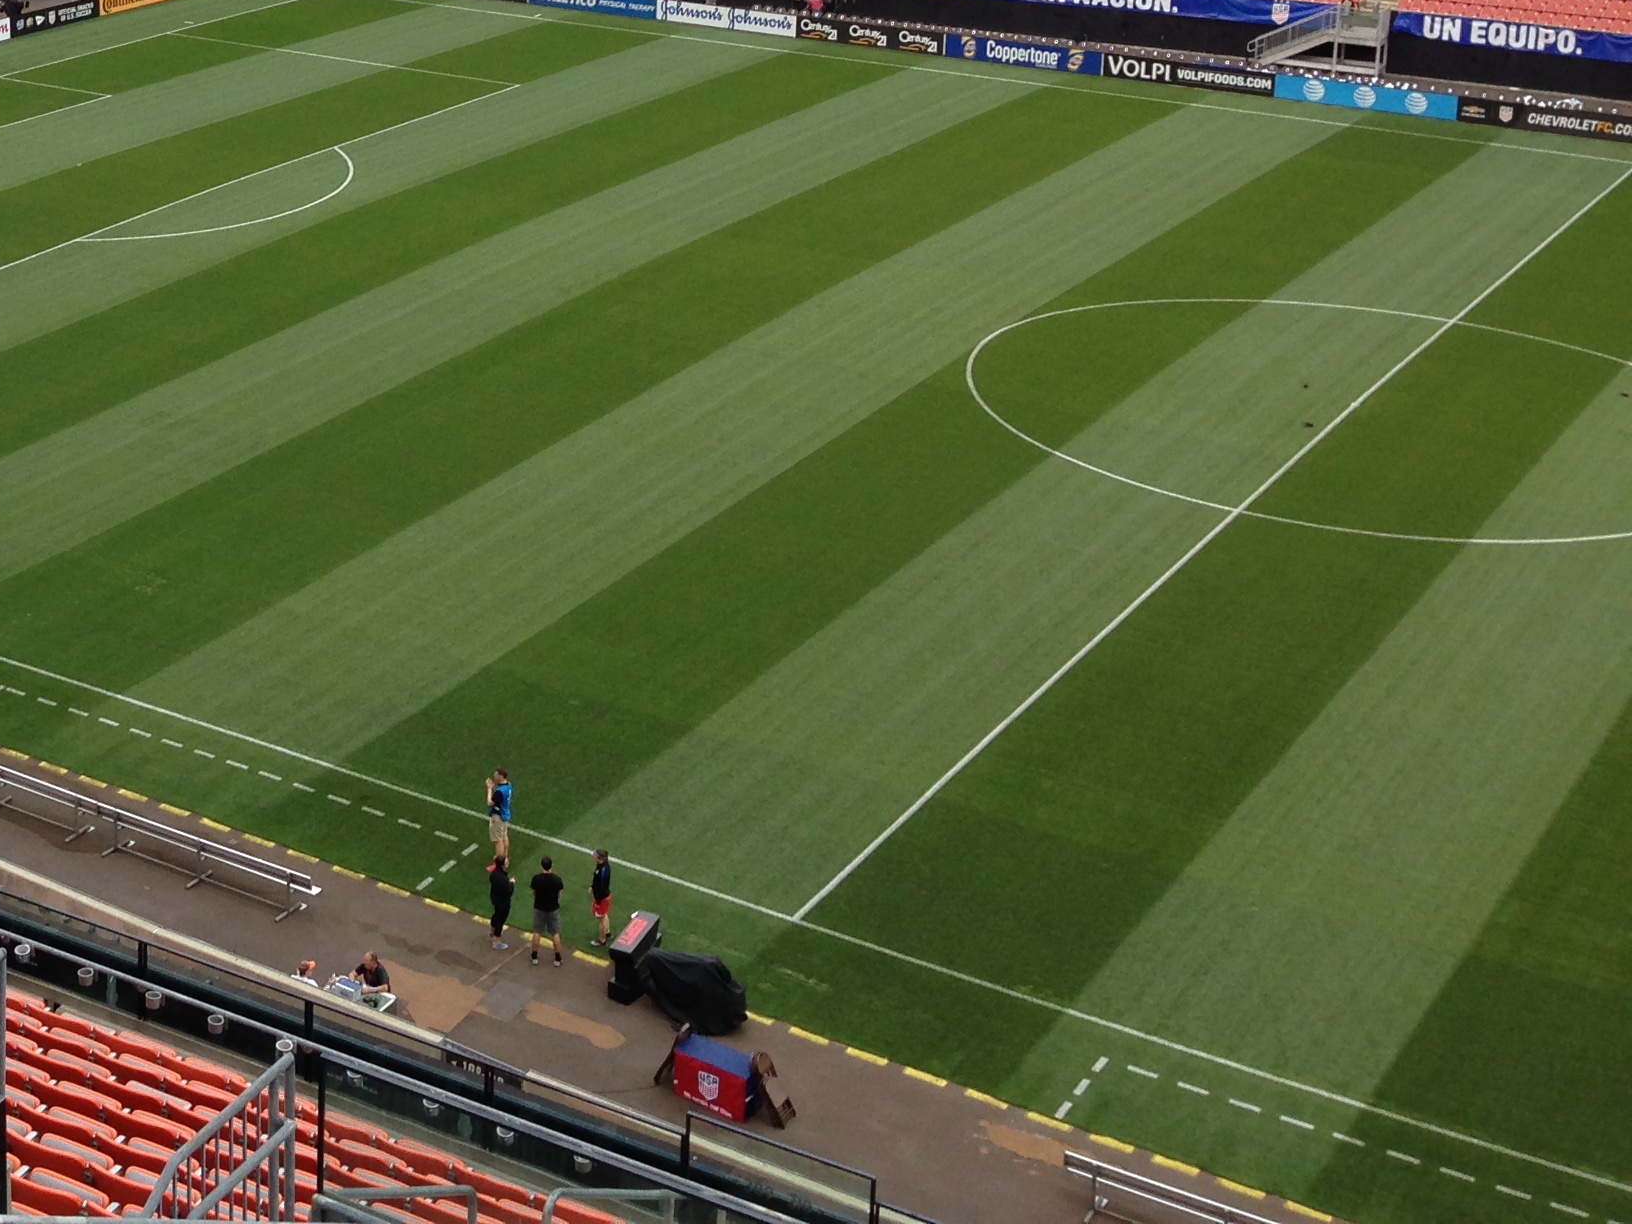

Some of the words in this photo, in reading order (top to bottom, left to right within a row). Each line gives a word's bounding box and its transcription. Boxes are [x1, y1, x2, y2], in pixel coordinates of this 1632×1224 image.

[1422, 15, 1462, 42] UN
[1470, 21, 1582, 55] EQUIPO.
[986, 40, 1058, 66] Coppertone
[1108, 56, 1171, 82] VOLPI
[1177, 68, 1272, 90] VOLPIFOODS.COM
[699, 1073, 718, 1086] USA
